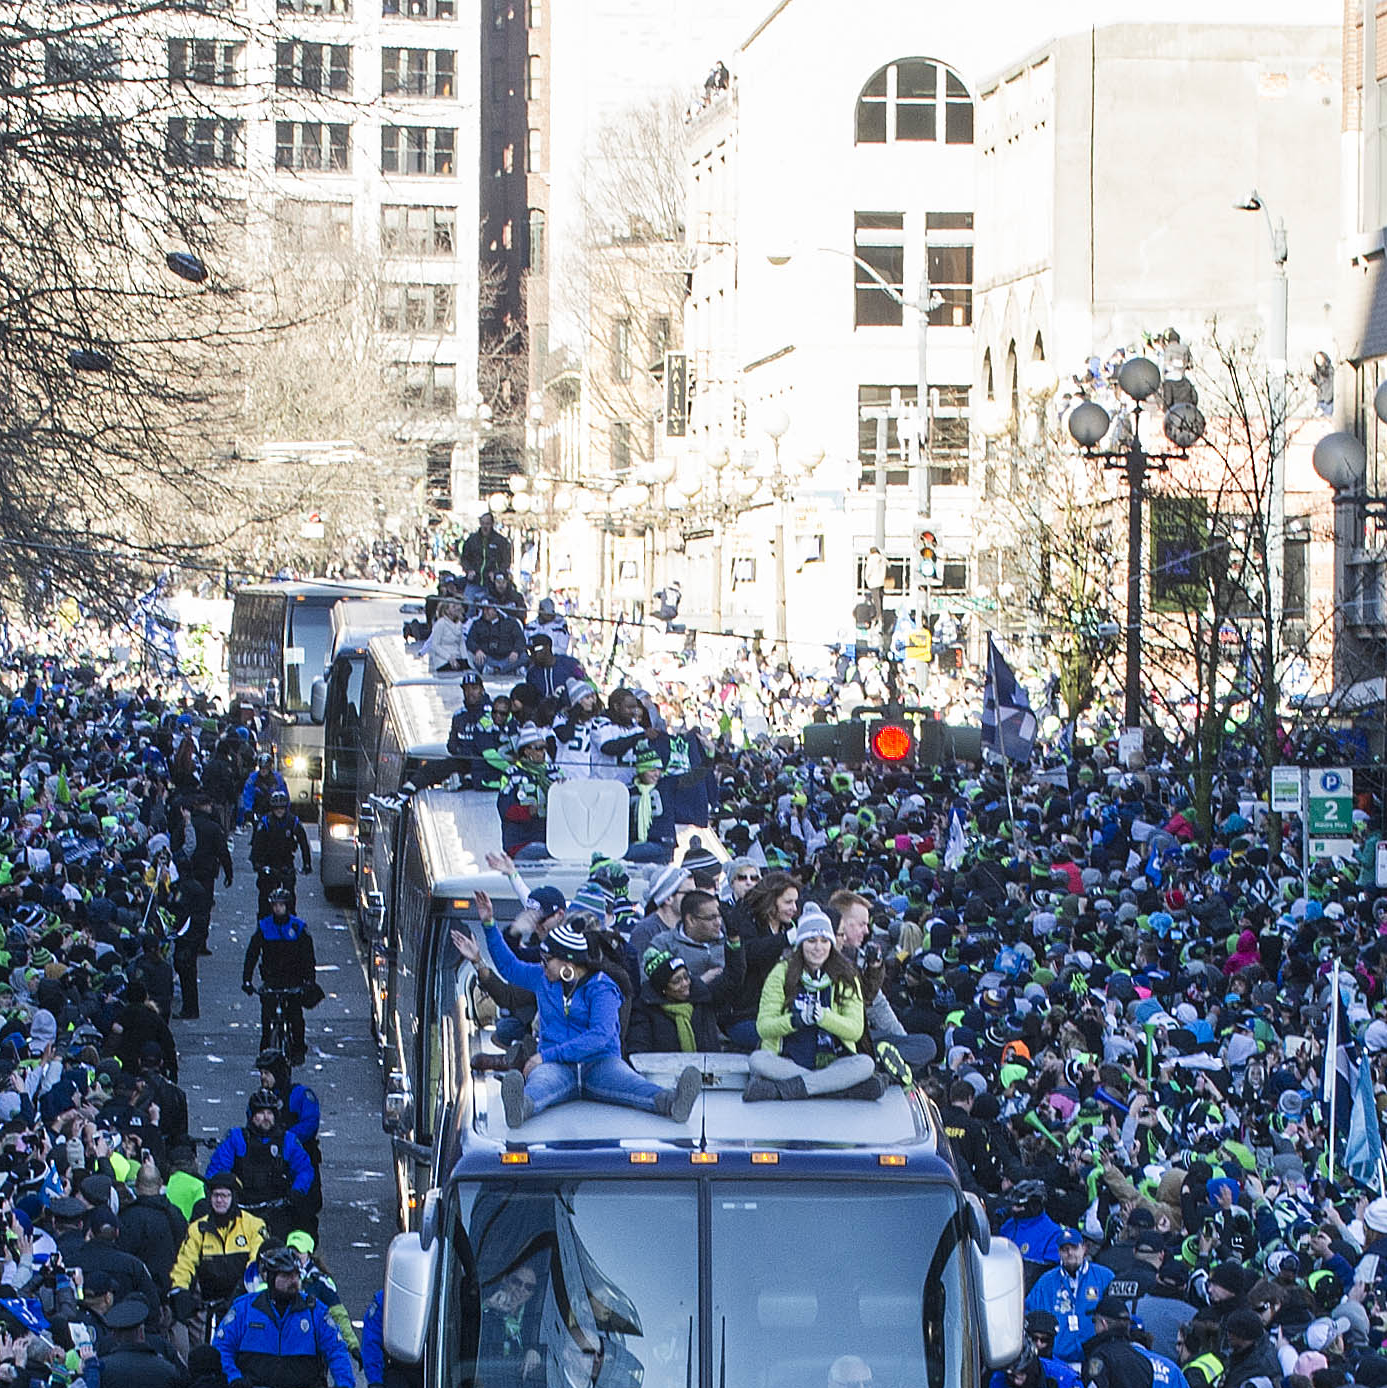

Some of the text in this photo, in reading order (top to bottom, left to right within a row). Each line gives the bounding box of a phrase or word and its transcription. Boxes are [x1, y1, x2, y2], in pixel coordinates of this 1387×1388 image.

[1326, 775, 1338, 790] P
[1324, 800, 1339, 821] 2
[945, 1127, 966, 1138] RIFF
[1110, 1282, 1138, 1296] POLICE
